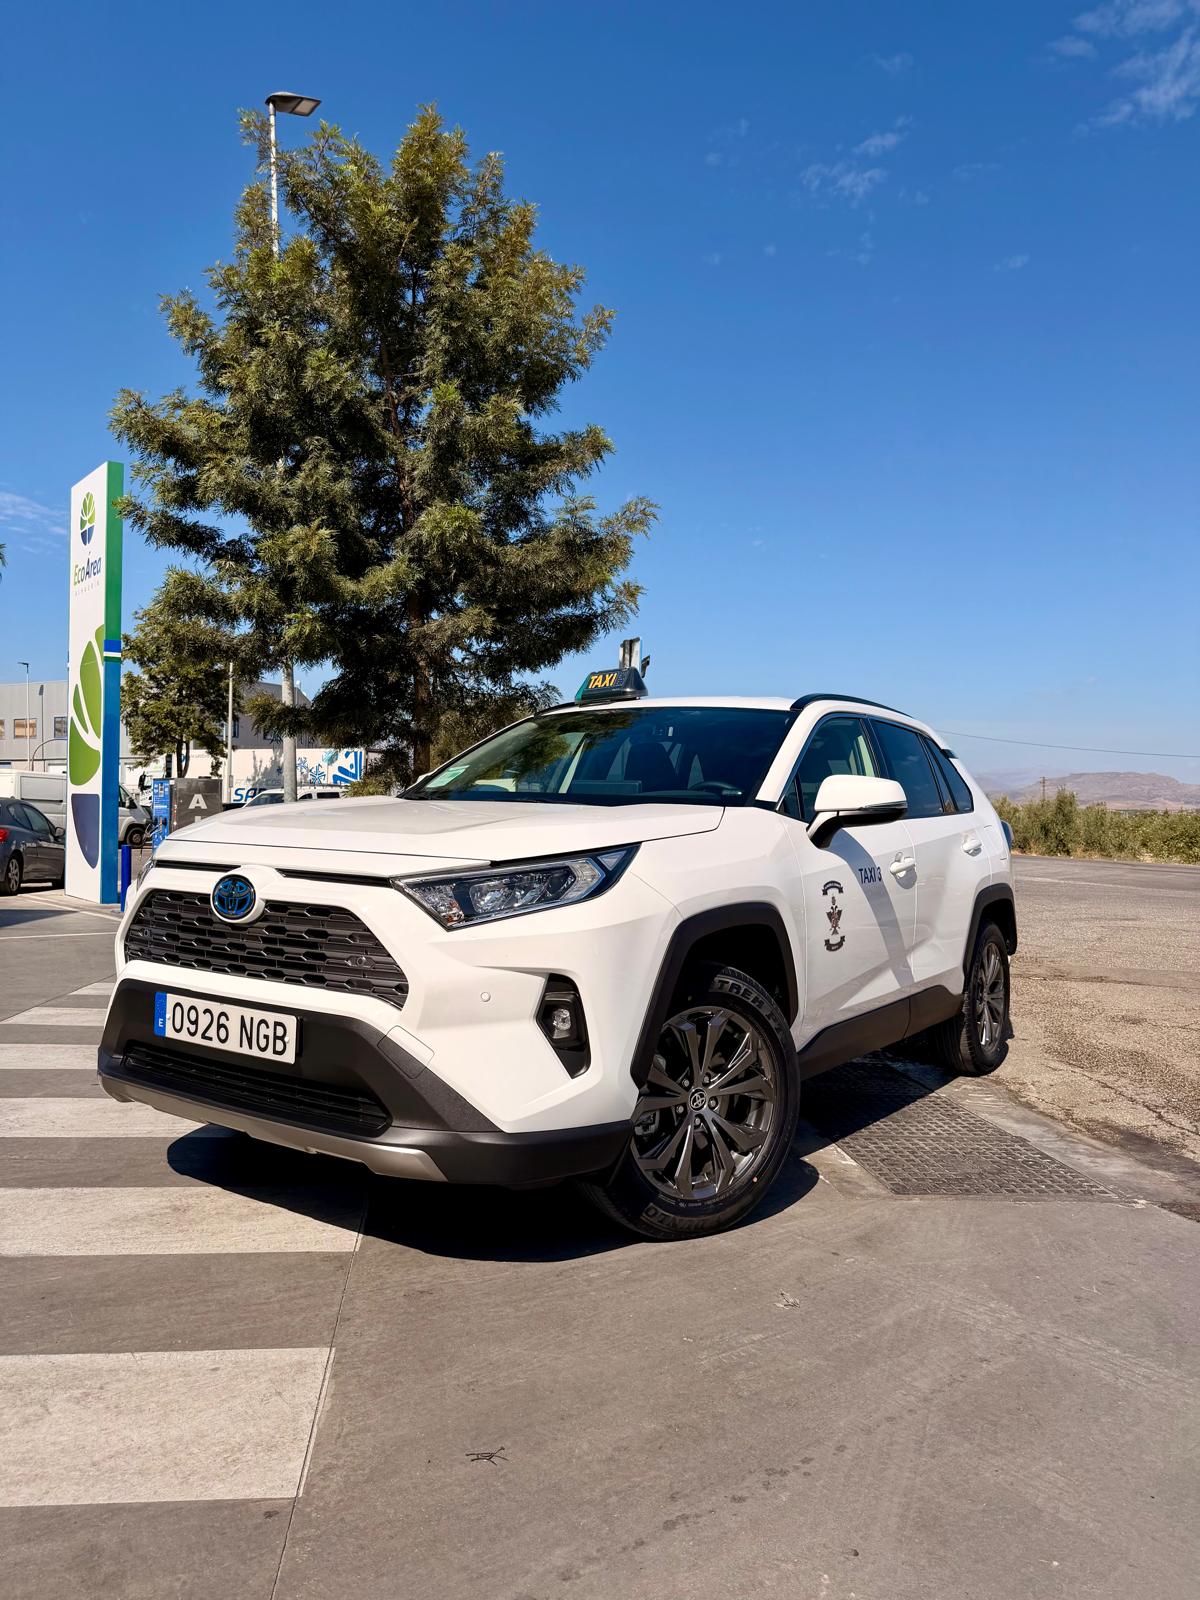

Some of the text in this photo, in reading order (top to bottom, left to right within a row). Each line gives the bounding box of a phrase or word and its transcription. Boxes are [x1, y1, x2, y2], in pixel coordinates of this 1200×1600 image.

[588, 673, 617, 689] TAXI
[858, 867, 882, 884] TAXI 3
[158, 1002, 288, 1056] E 0926 NGB
